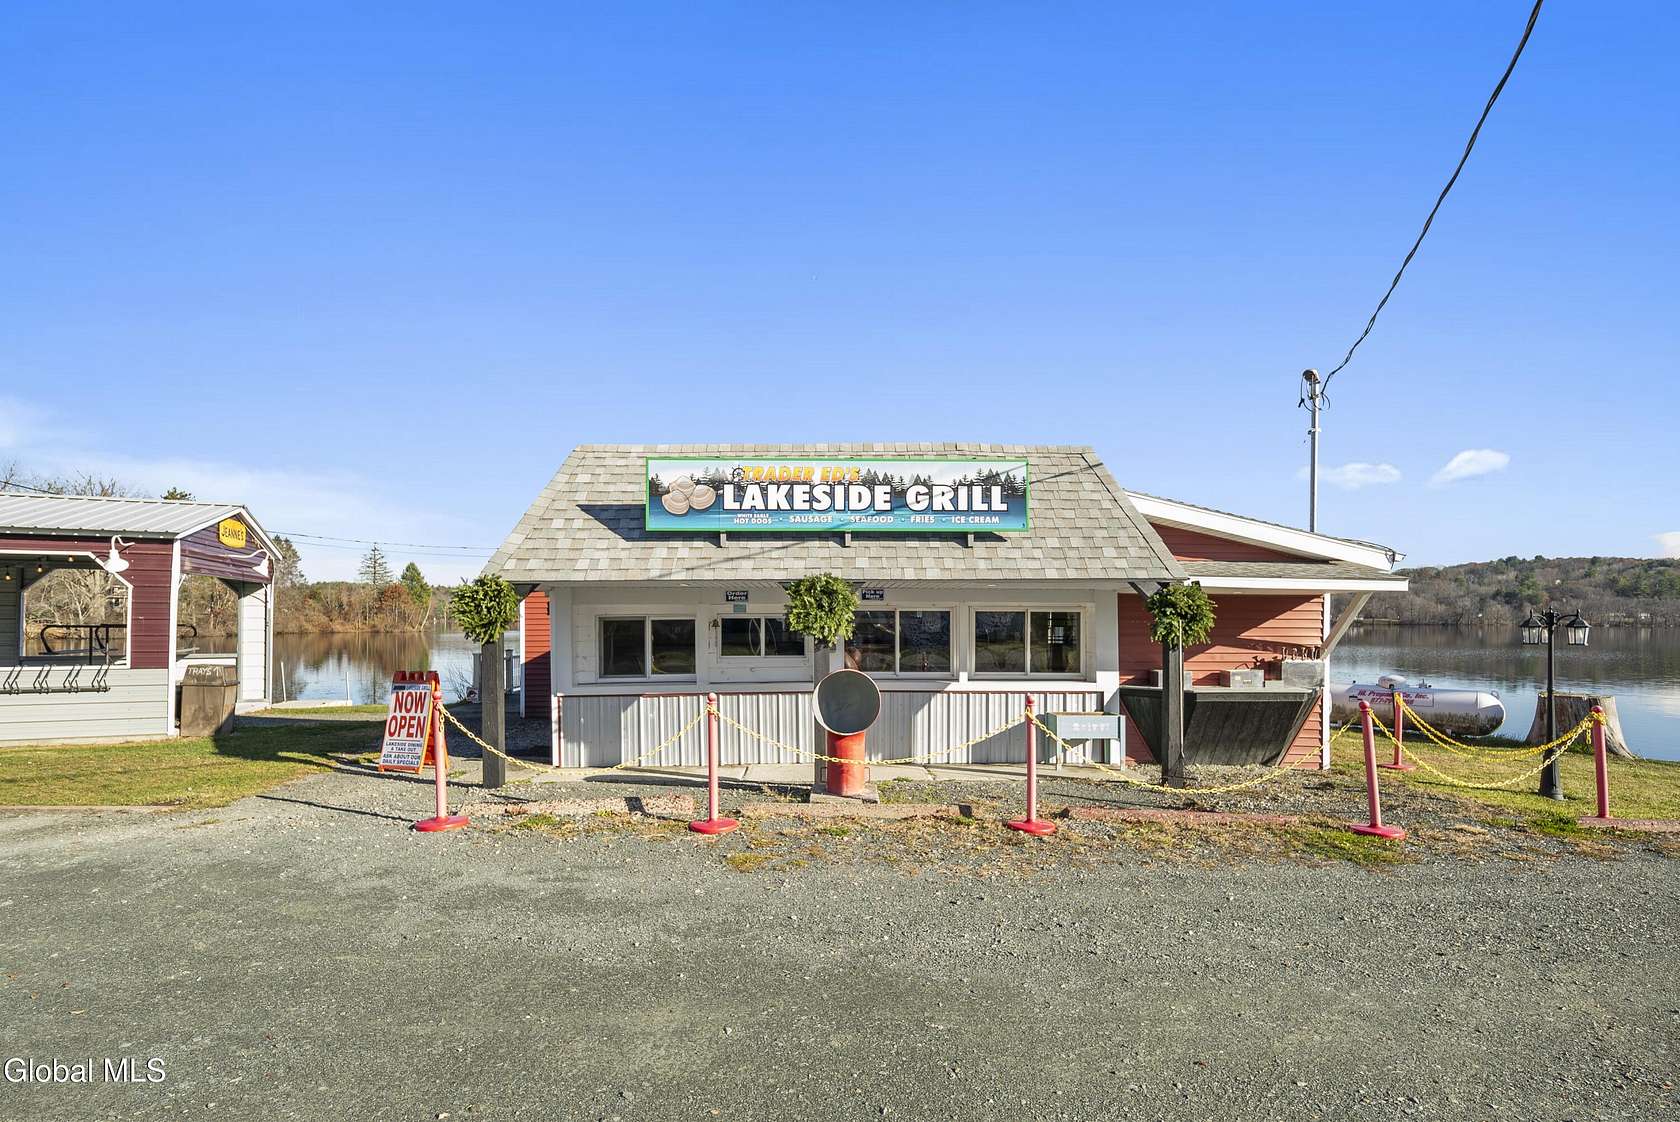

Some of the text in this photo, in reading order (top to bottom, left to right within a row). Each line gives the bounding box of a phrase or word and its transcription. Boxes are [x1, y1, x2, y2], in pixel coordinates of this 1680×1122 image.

[742, 465, 861, 481] TRADER ED'S
[722, 484, 1008, 511] LAKESIDE GRILL
[789, 515, 833, 523] SAUSAGE
[850, 515, 894, 523] SEAFOOD
[910, 515, 935, 523] FRIES
[188, 666, 212, 676] TRAYS
[394, 691, 427, 713] NOW
[388, 715, 426, 738] OPEN
